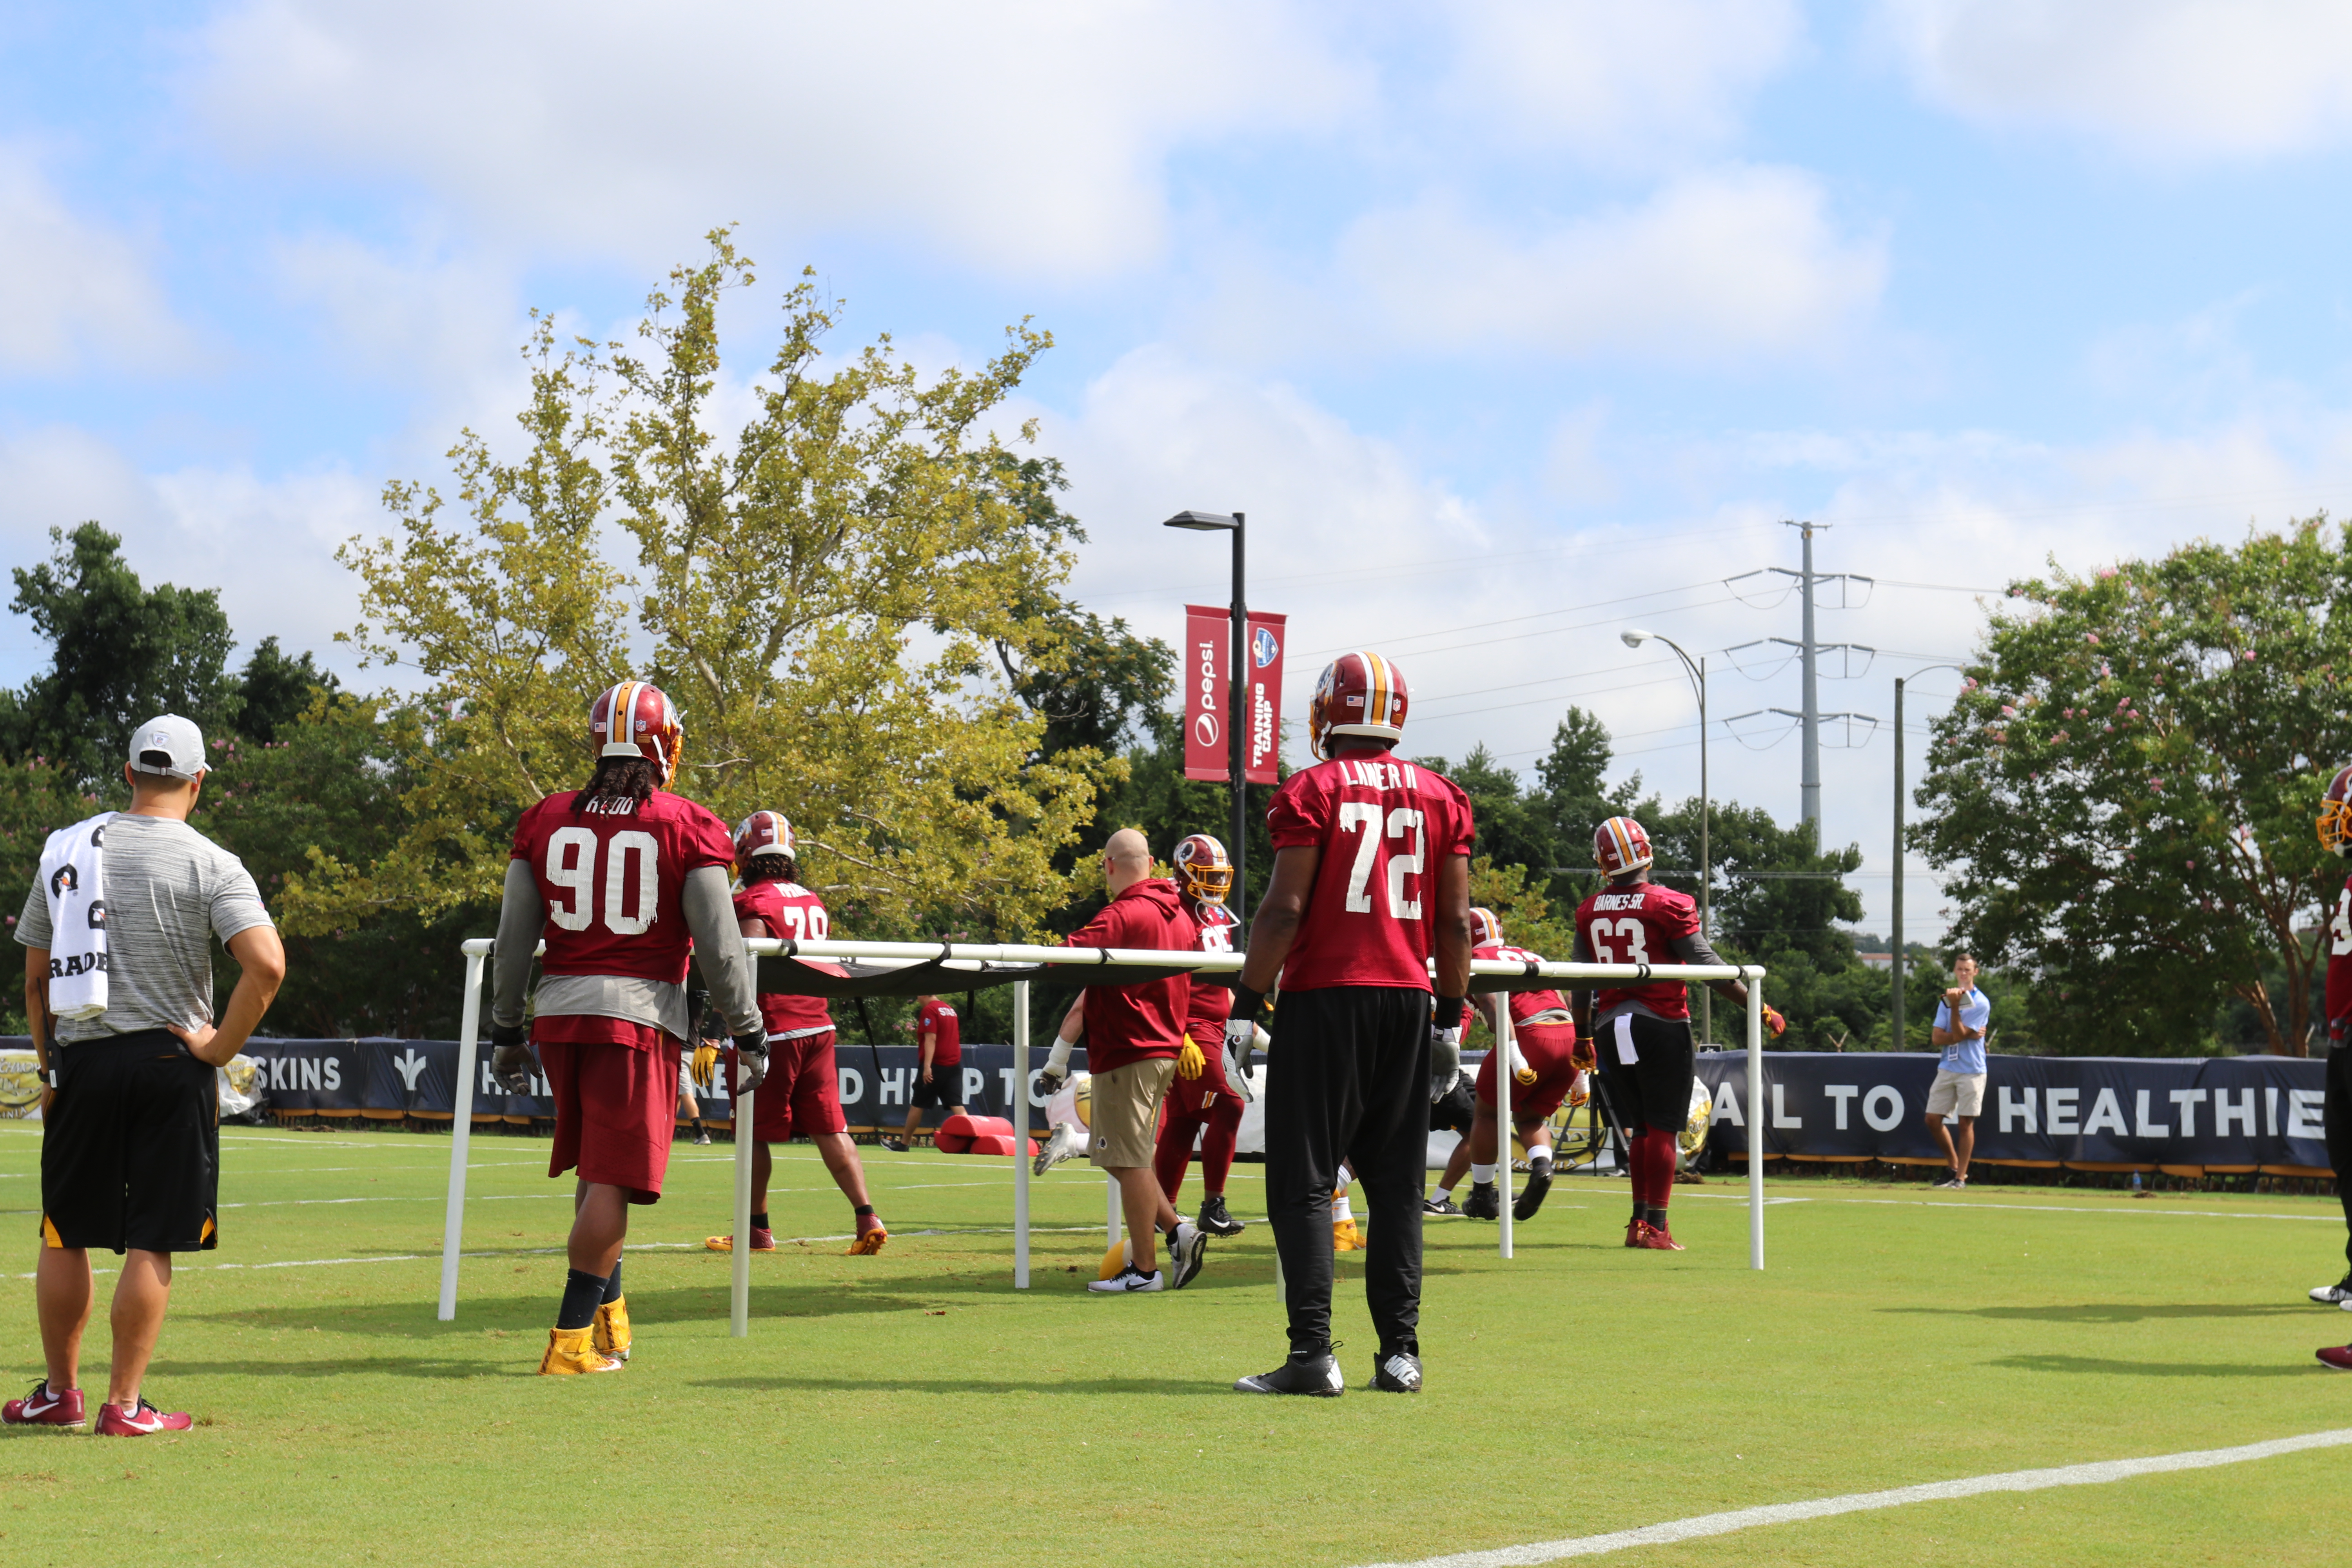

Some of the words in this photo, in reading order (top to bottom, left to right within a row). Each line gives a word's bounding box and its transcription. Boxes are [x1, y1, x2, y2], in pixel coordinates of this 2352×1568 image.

[1199, 643, 1216, 710] pepsi
[1253, 683, 1265, 767] TRAINING
[1262, 701, 1273, 752] CAMP
[1403, 764, 1417, 789] II
[546, 826, 659, 935] 90
[1339, 802, 1425, 920] 72
[1593, 894, 1631, 911] BARNES
[1628, 893, 1645, 909] SR.
[1590, 918, 1649, 964] 63
[1825, 1085, 1905, 1132] TO
[1998, 1086, 2326, 1140] HEALTHIE
[1384, 1354, 1420, 1386] NIKE
